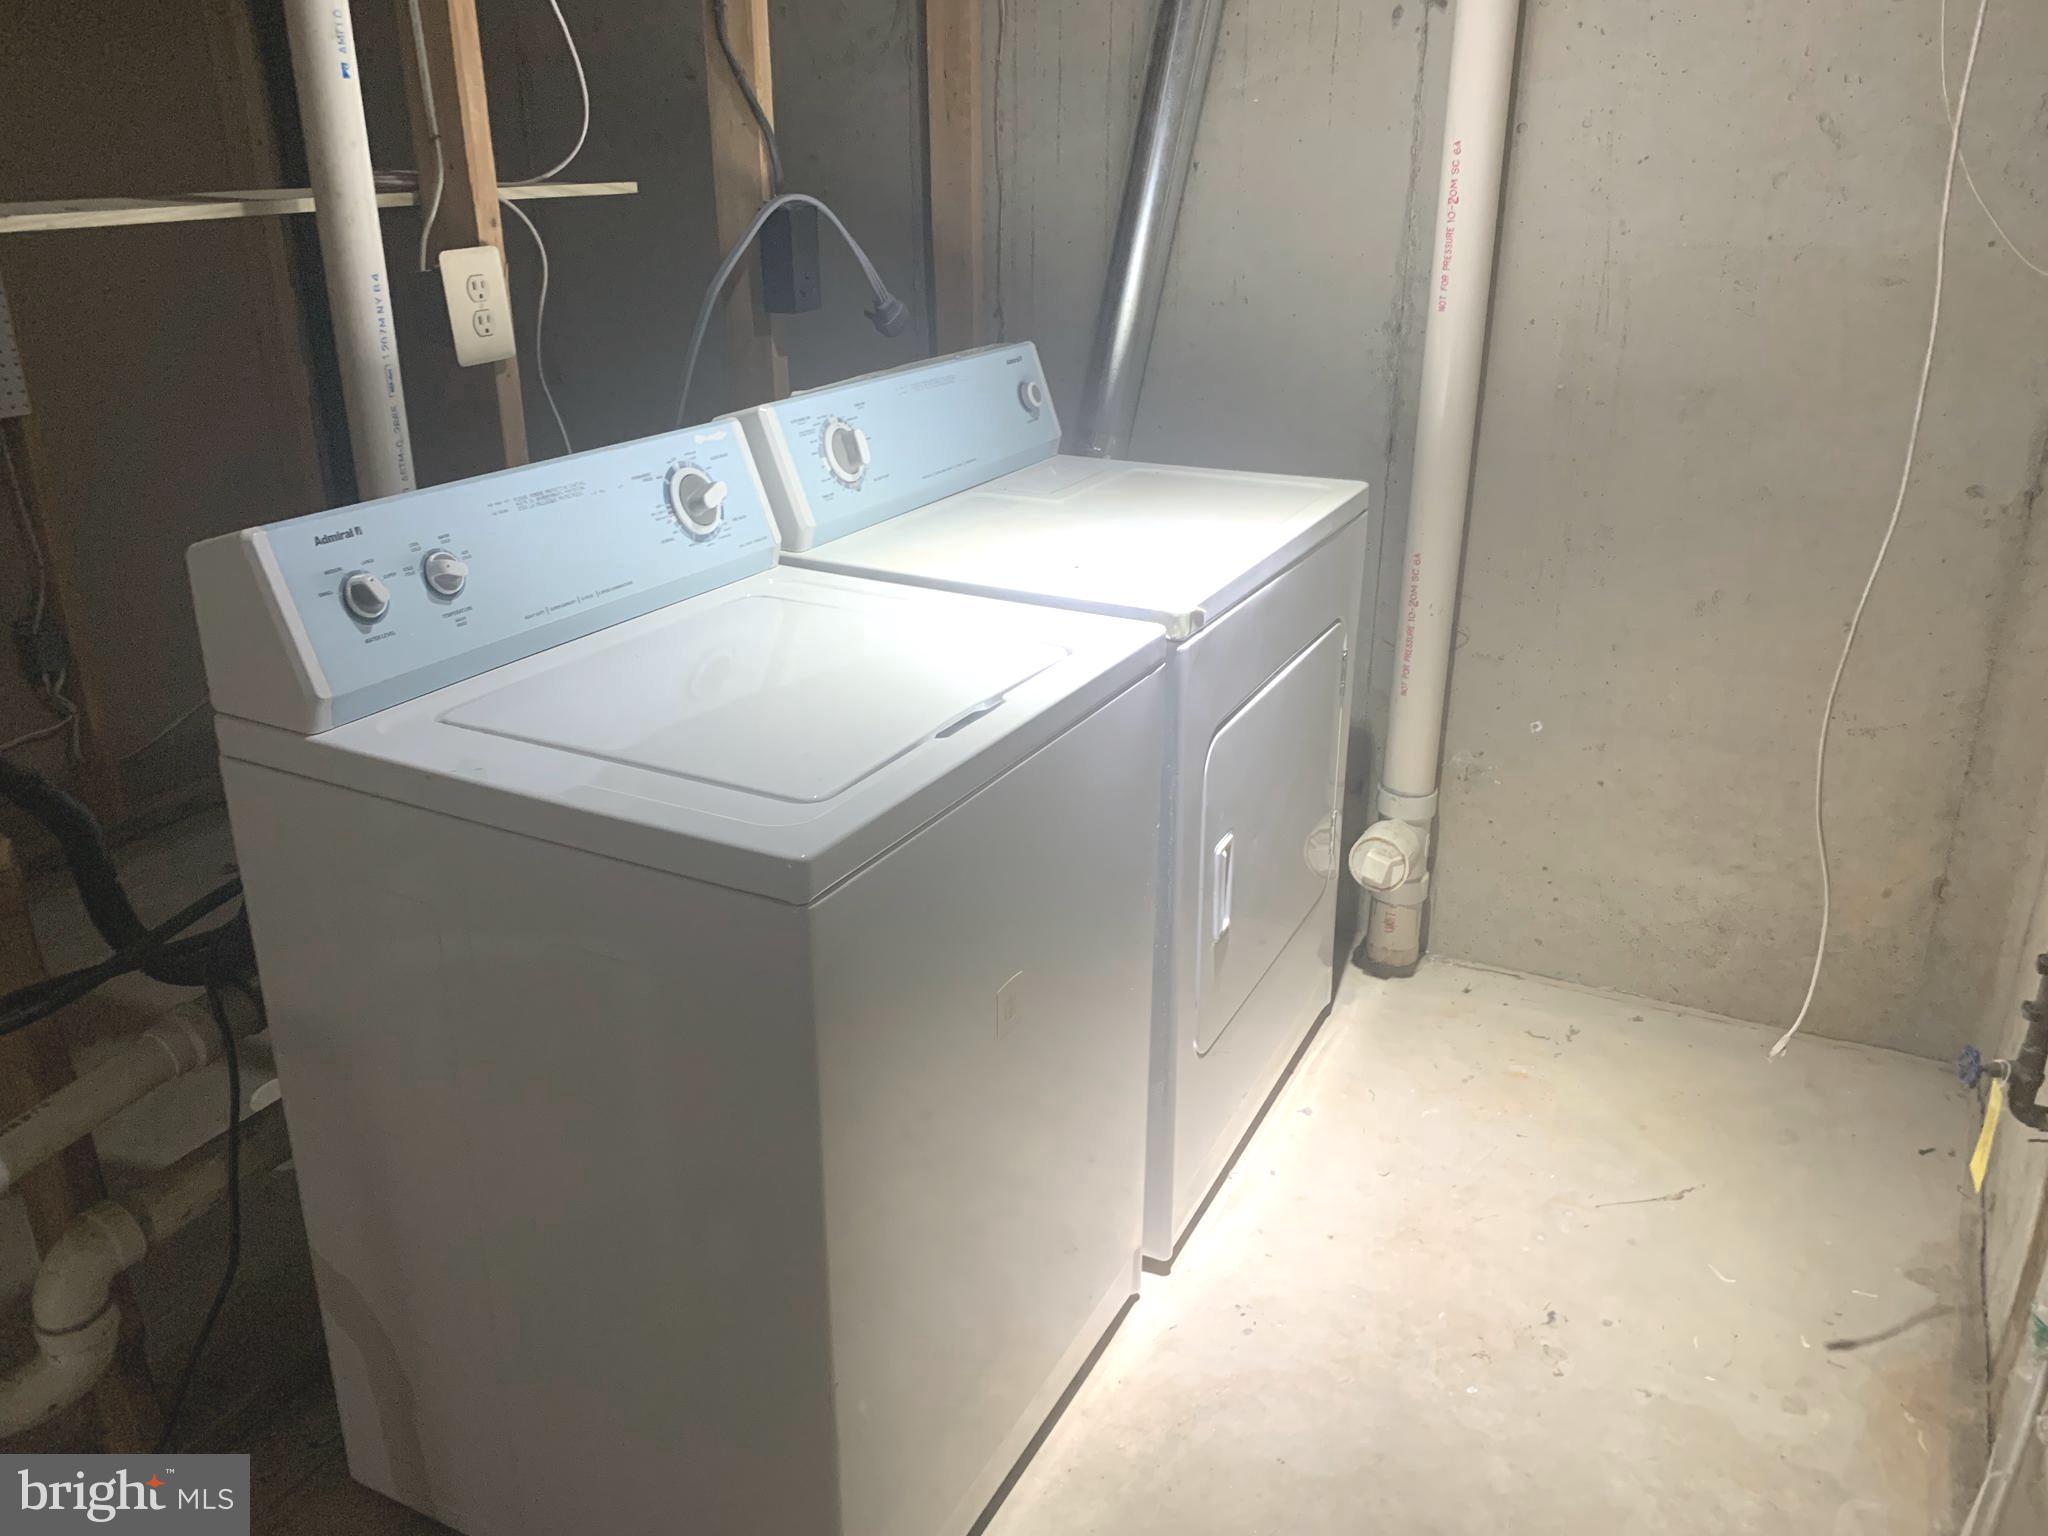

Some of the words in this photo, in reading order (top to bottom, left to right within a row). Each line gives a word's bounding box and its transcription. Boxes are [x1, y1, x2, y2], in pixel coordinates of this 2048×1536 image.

[1453, 140, 1462, 155] 6A
[1451, 159, 1460, 174] SC
[1442, 227, 1455, 271] PRESSURE
[1440, 274, 1449, 291] FOR
[1437, 296, 1447, 312] NOT
[314, 528, 355, 546] Admiral
[1411, 568, 1420, 582] SC
[1403, 625, 1415, 662] PRESSURE
[1401, 664, 1411, 680] FOR
